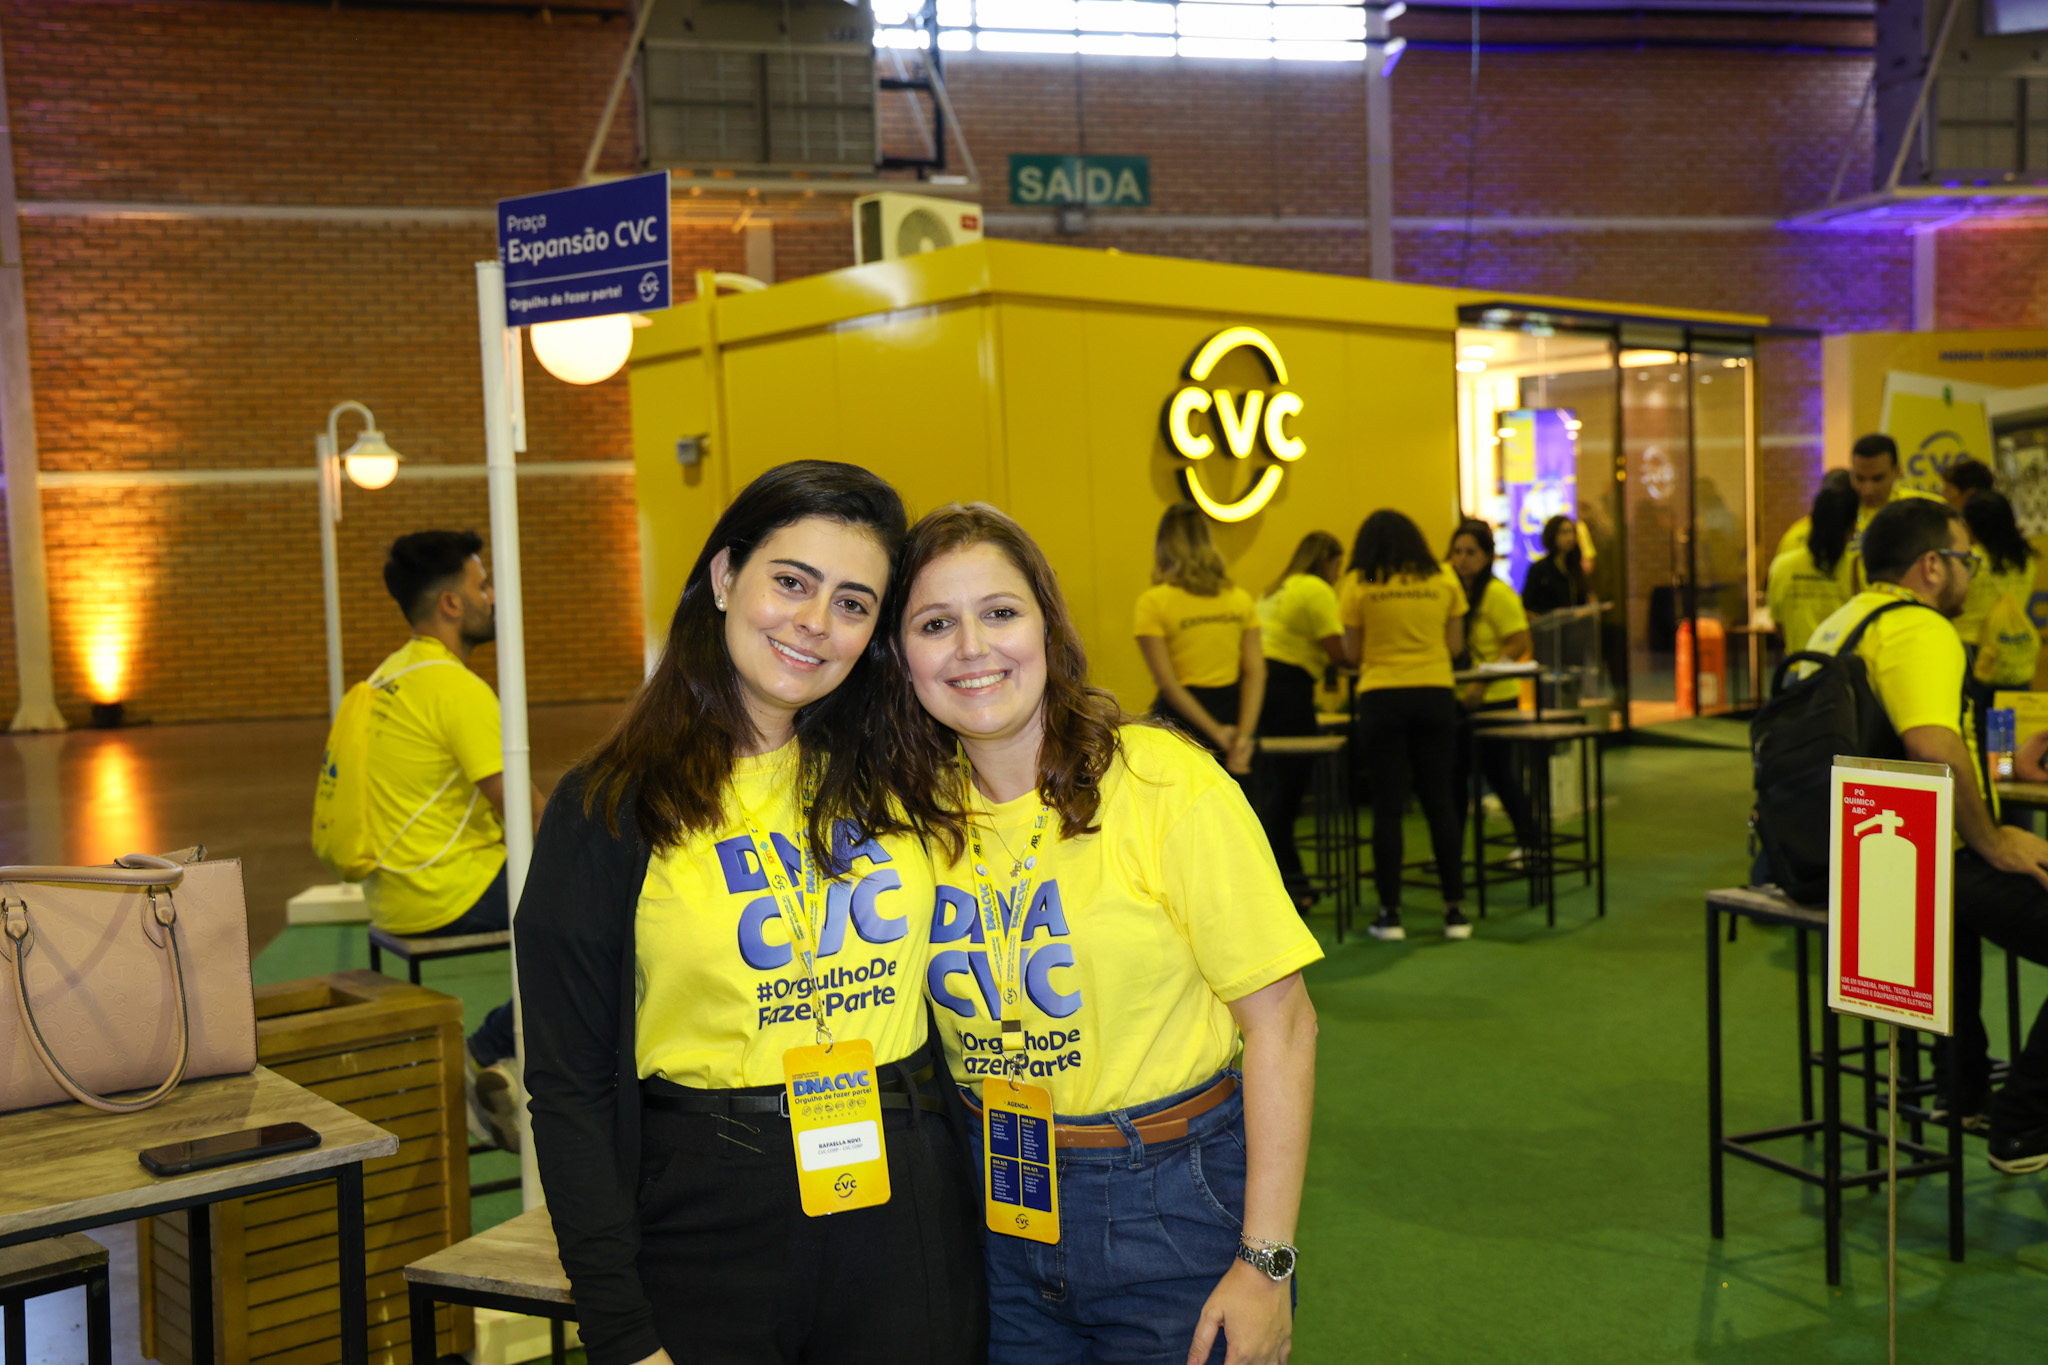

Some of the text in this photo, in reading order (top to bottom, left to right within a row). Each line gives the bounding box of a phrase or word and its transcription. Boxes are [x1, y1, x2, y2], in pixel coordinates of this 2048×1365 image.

[1018, 158, 1144, 203] SAÍDA
[507, 214, 547, 234] Praça
[508, 216, 658, 266] Expansão CVC
[509, 284, 623, 313] Orgulho de fazer parte!
[638, 280, 660, 296] CVC
[1169, 386, 1307, 462] CVC
[1852, 807, 1867, 815] ABC
[714, 818, 893, 894] DNA
[929, 878, 1070, 944] DNA
[979, 883, 996, 931] DNA CVC
[1011, 878, 1028, 928] DNA CVC
[738, 868, 909, 971] CVC
[757, 957, 897, 1003] #OrgulhoDe
[926, 943, 1084, 1021] CVC
[1841, 976, 1850, 984] USE
[758, 985, 896, 1030] FazerParte
[965, 1050, 1081, 1078] azerParte
[793, 1076, 835, 1097] DNA
[835, 1070, 870, 1090] CVC
[794, 1088, 872, 1105] Orgulho de fazer parte!
[1007, 1101, 1029, 1110] AGENDA
[819, 1140, 846, 1149] RAFAELLA
[834, 1179, 857, 1192] CVC
[1015, 1216, 1029, 1226] CVC
